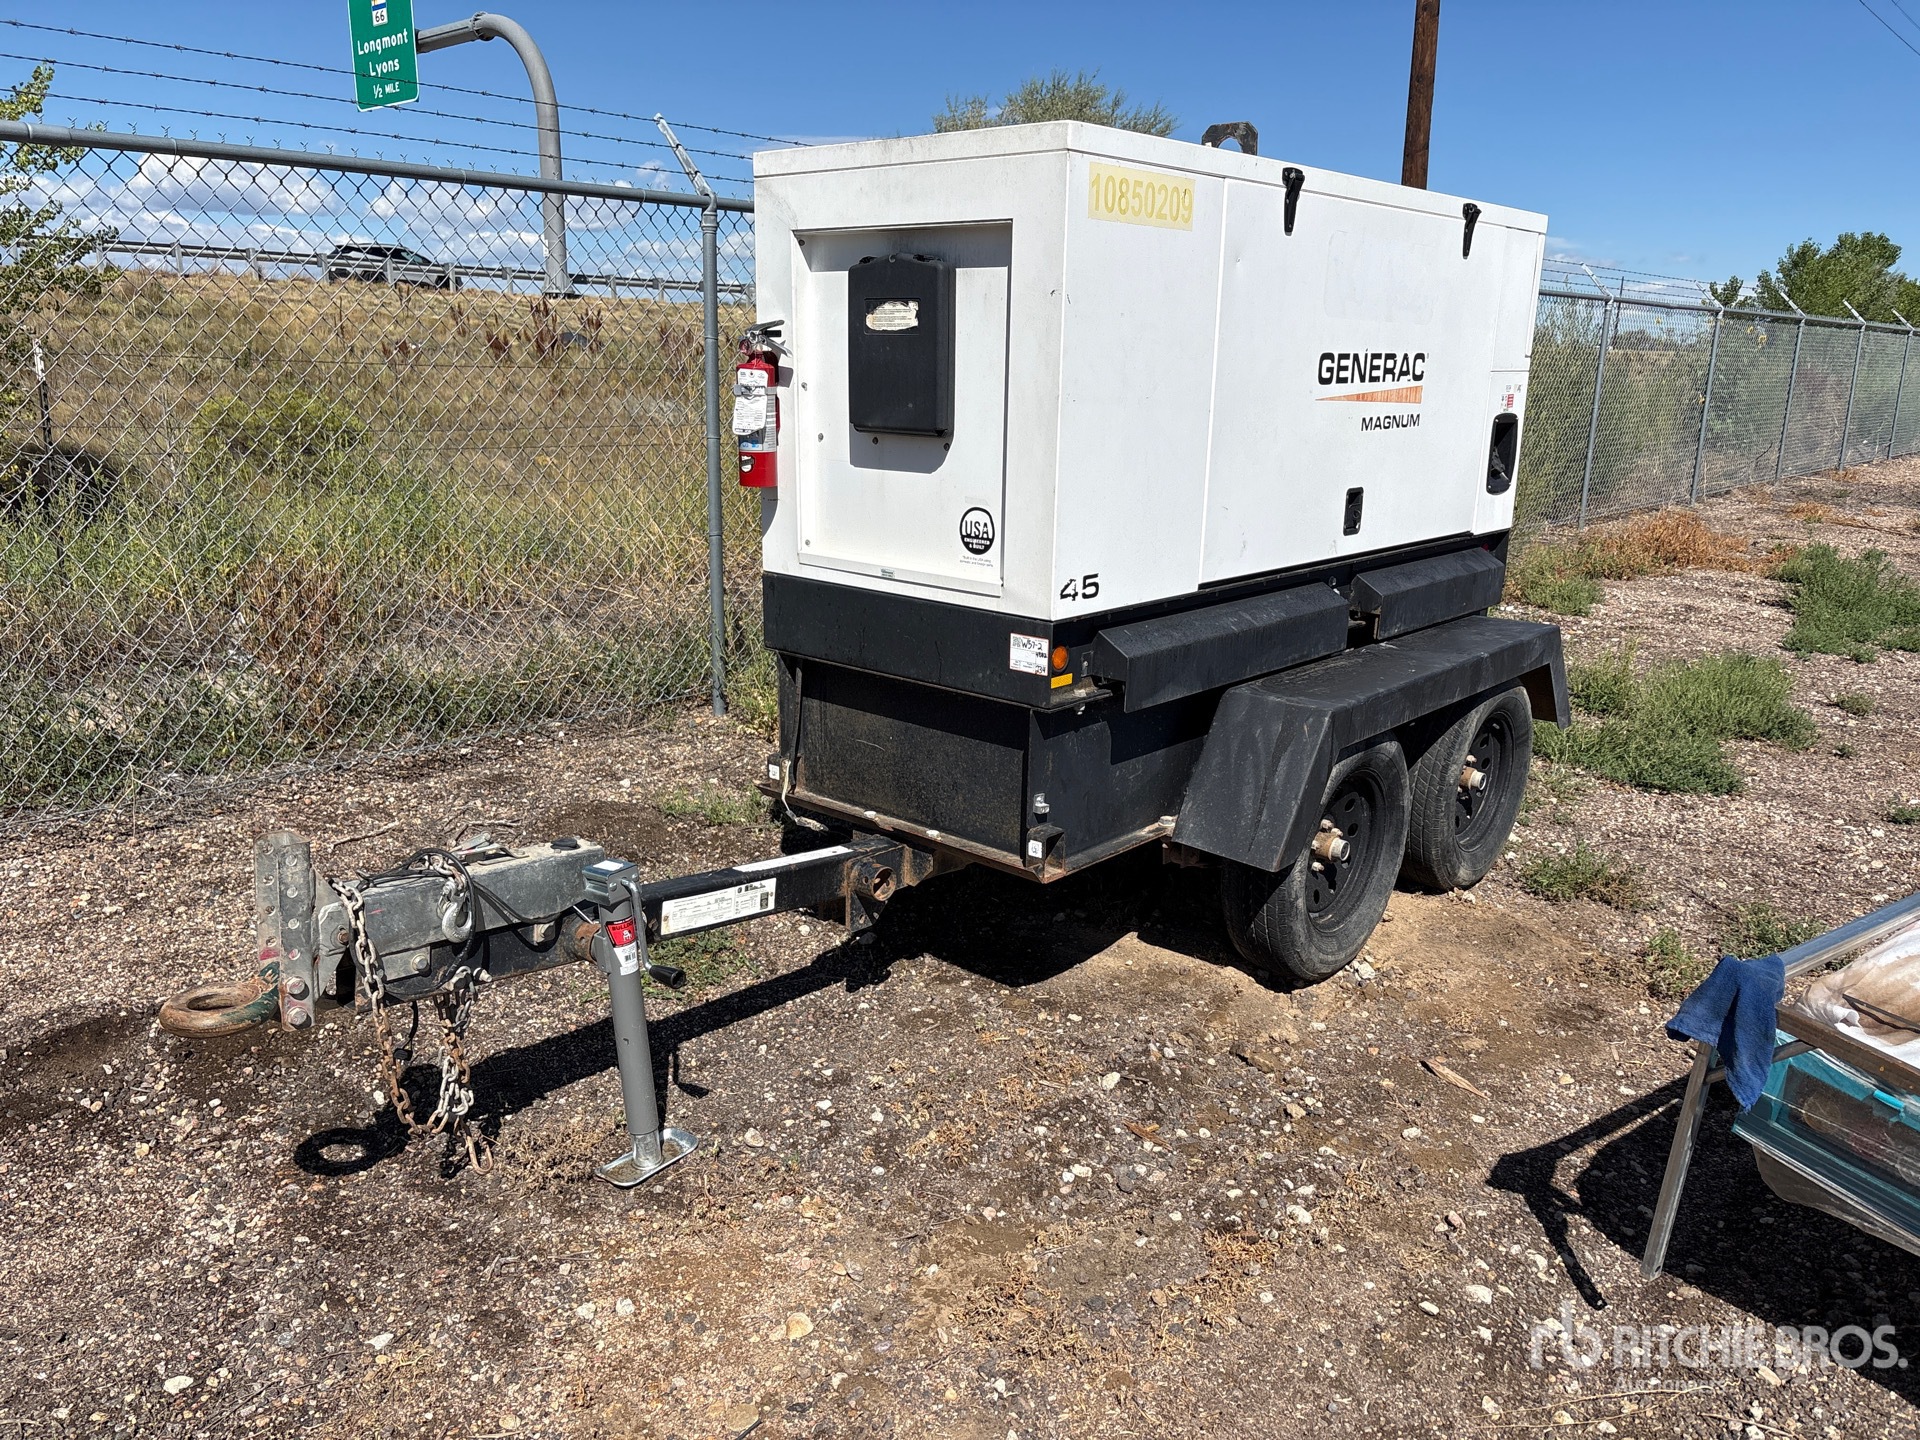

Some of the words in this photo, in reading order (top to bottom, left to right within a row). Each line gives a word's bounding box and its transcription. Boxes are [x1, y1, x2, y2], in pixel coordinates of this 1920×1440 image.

[375, 10, 385, 23] 66
[357, 28, 408, 55] Longmont
[369, 58, 400, 77] Lyons
[385, 82, 400, 94] MILE
[1091, 172, 1194, 224] 10850209
[1317, 351, 1426, 386] GENERAC
[1360, 413, 1421, 432] MAGNUM
[965, 520, 990, 539] USA
[1059, 572, 1100, 602] 45
